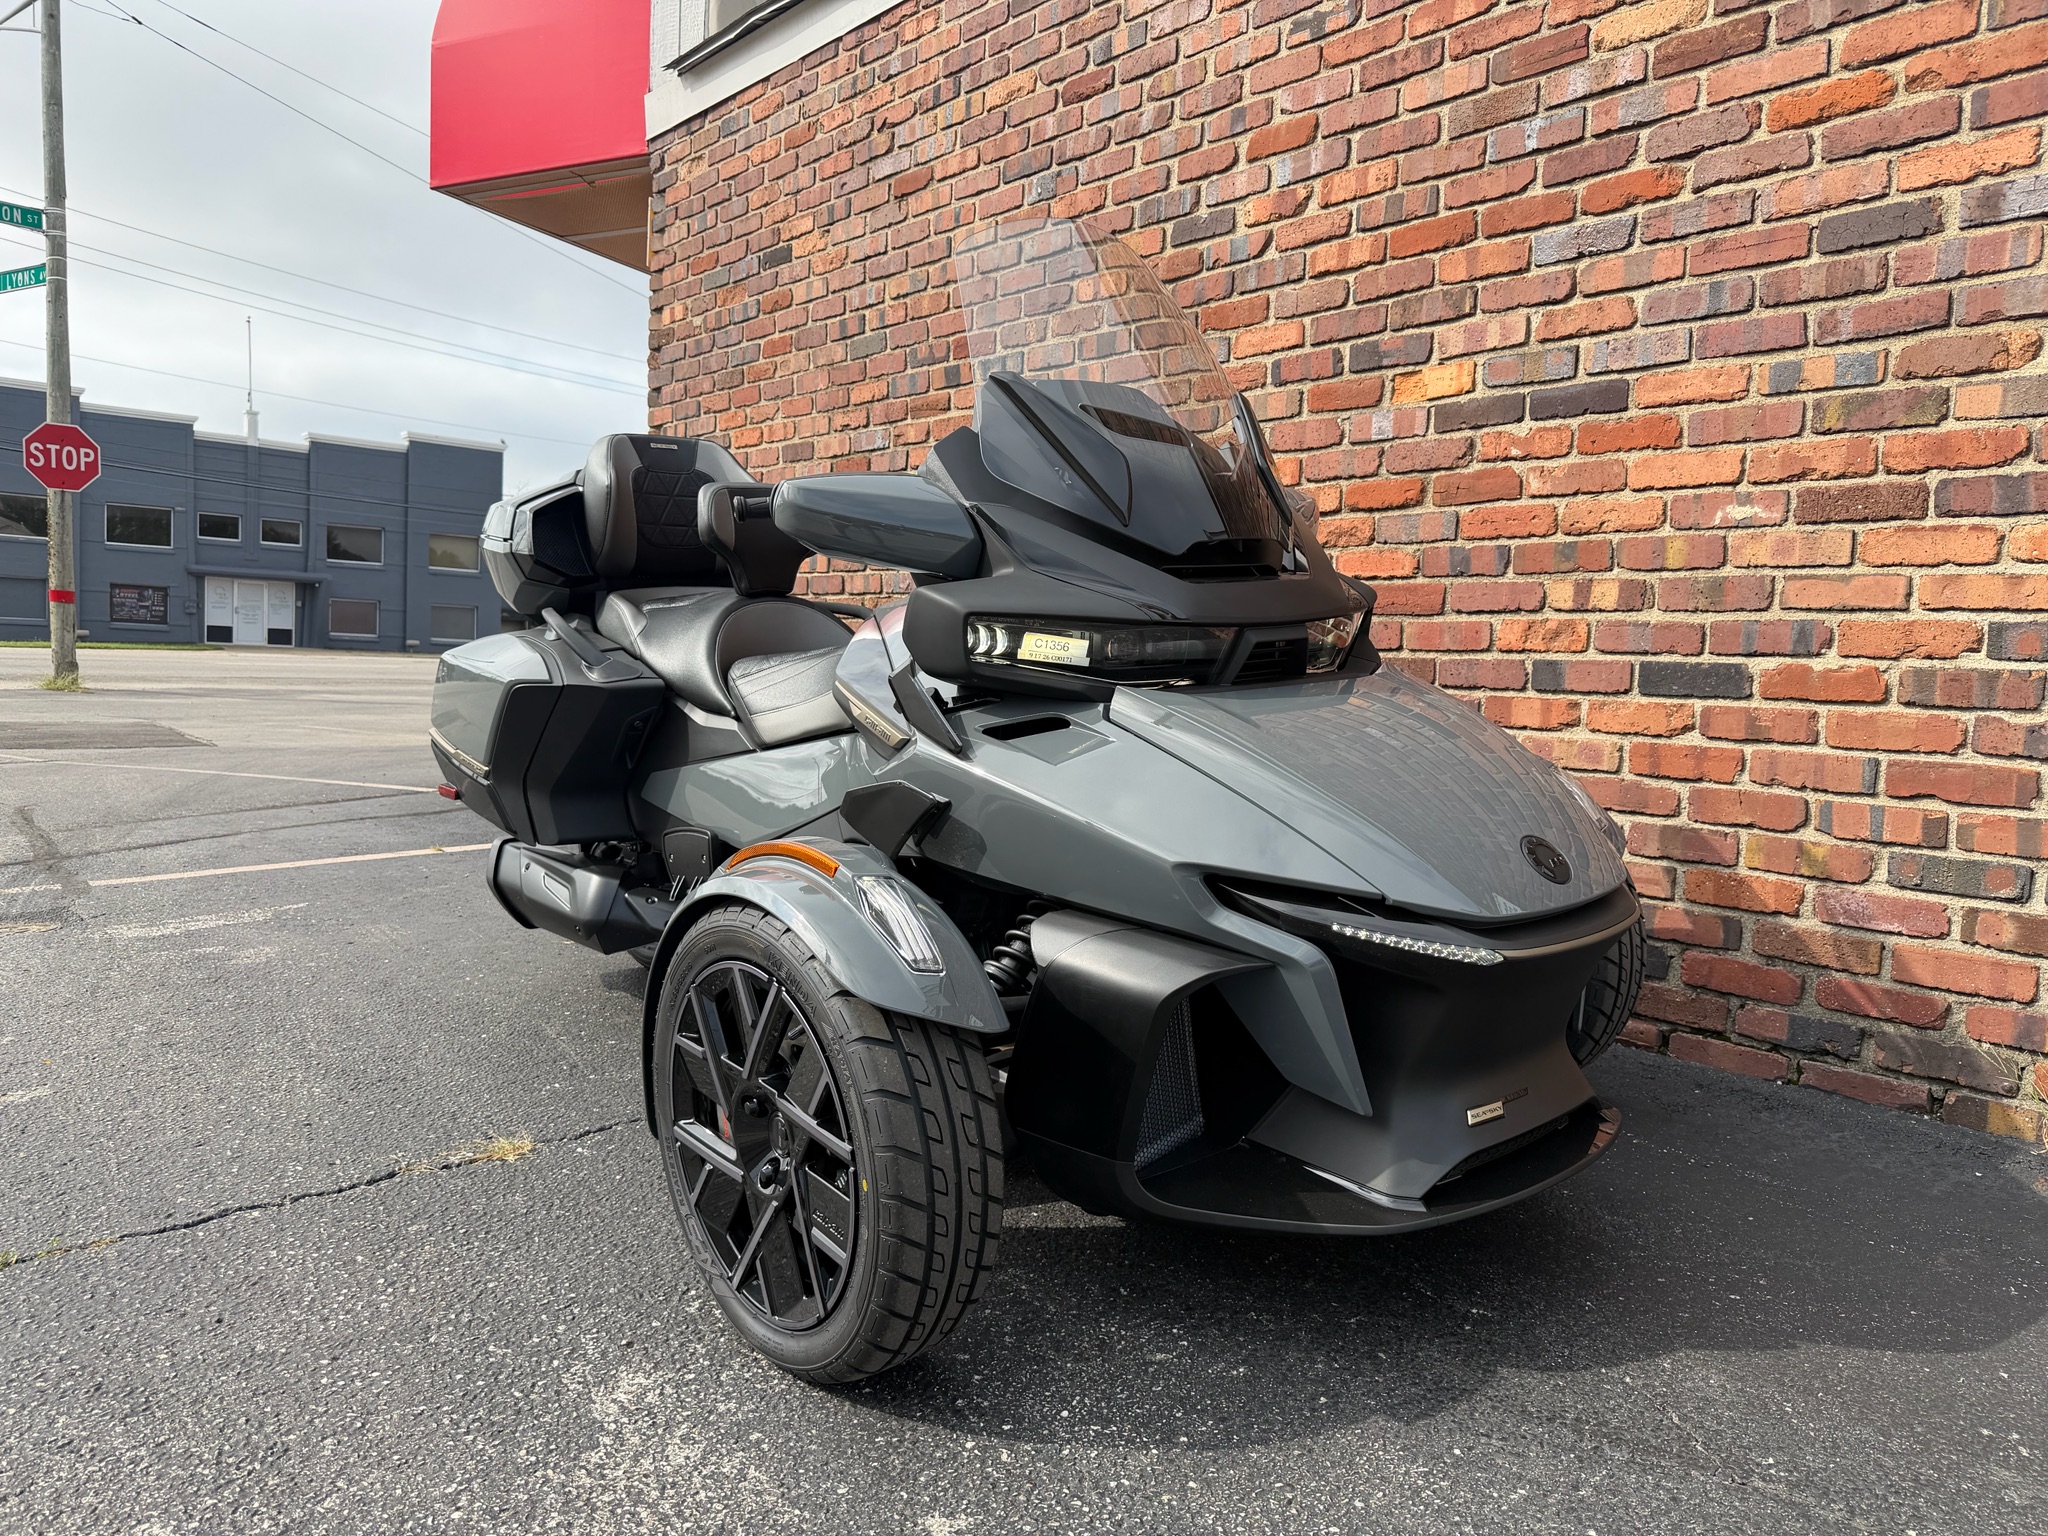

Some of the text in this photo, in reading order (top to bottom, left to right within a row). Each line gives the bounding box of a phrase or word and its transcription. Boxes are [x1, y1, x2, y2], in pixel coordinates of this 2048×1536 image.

[27, 214, 39, 224] ST
[6, 269, 36, 291] LYONS
[29, 442, 95, 472] STOP
[1034, 638, 1070, 652] C1356
[767, 951, 818, 1019] KENDA
